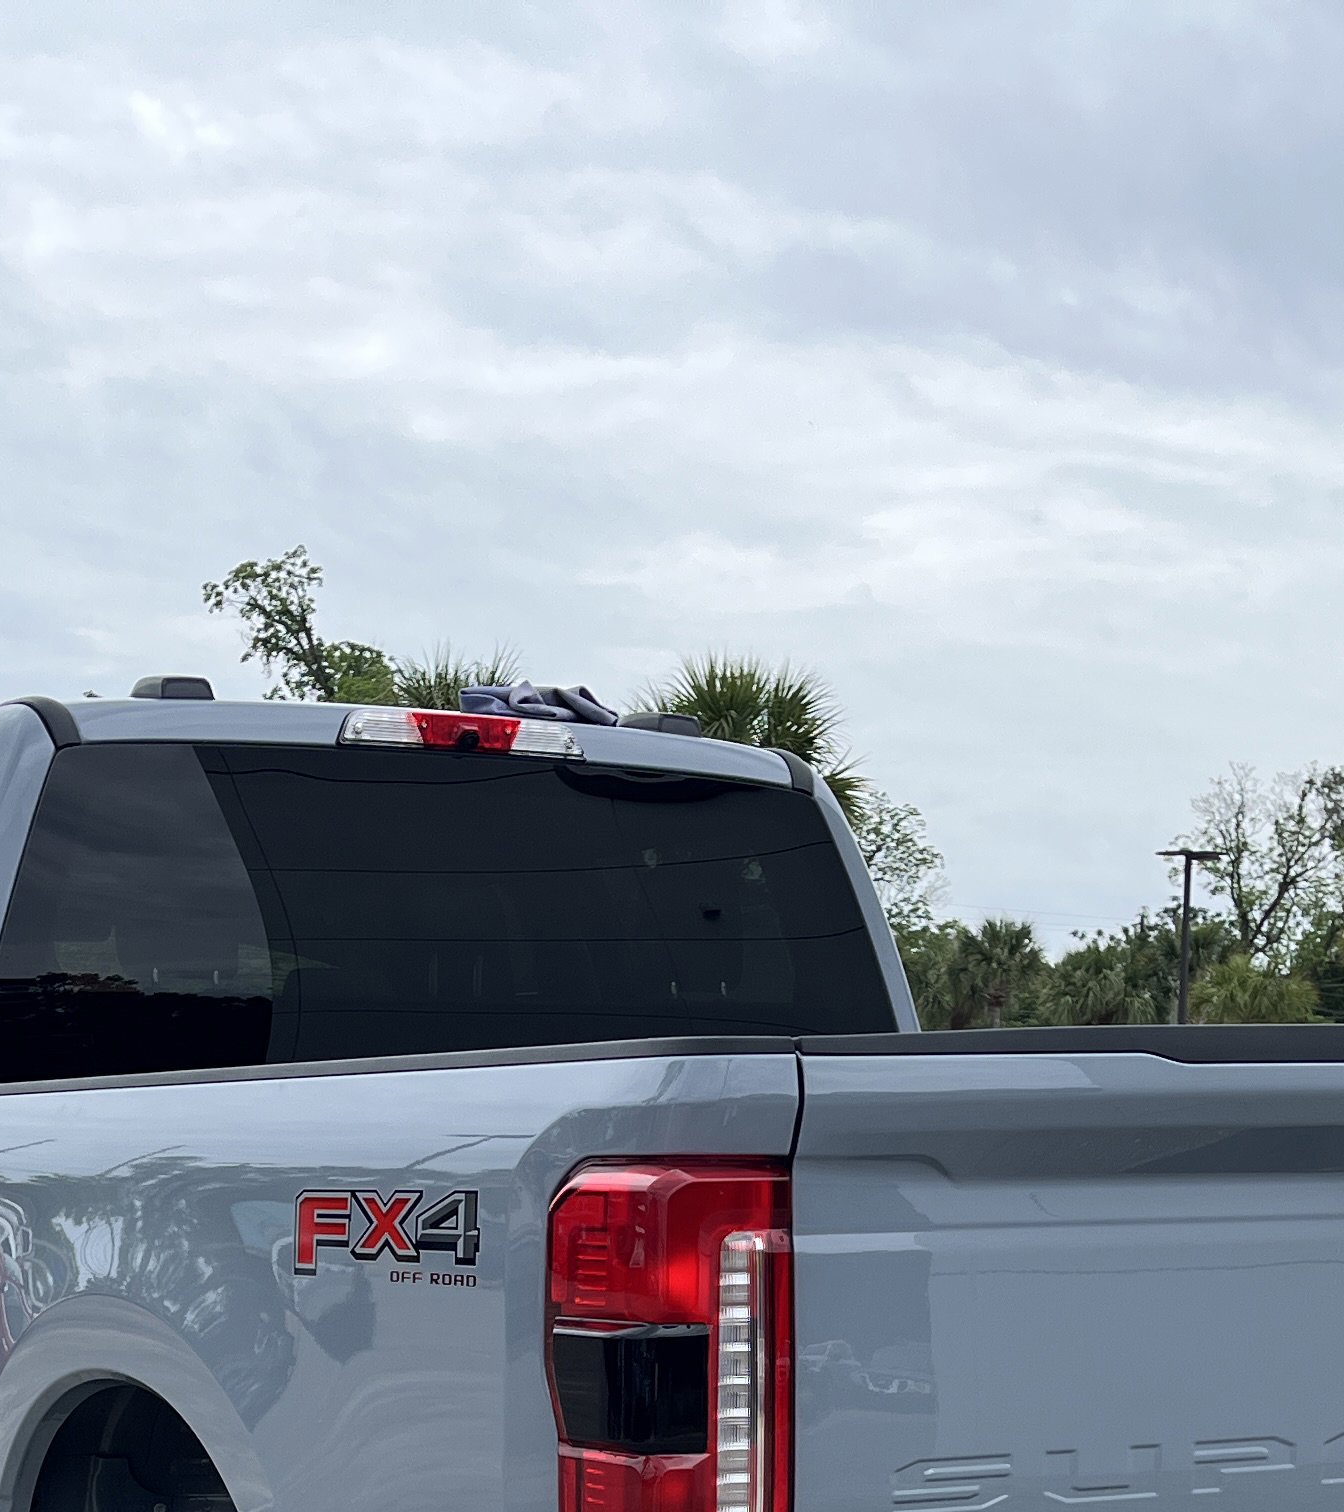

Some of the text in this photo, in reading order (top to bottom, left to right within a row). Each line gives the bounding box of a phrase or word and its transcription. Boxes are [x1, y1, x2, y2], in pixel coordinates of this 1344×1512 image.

[294, 1188, 480, 1277] FX4
[390, 1271, 477, 1288] OFF ROAD
